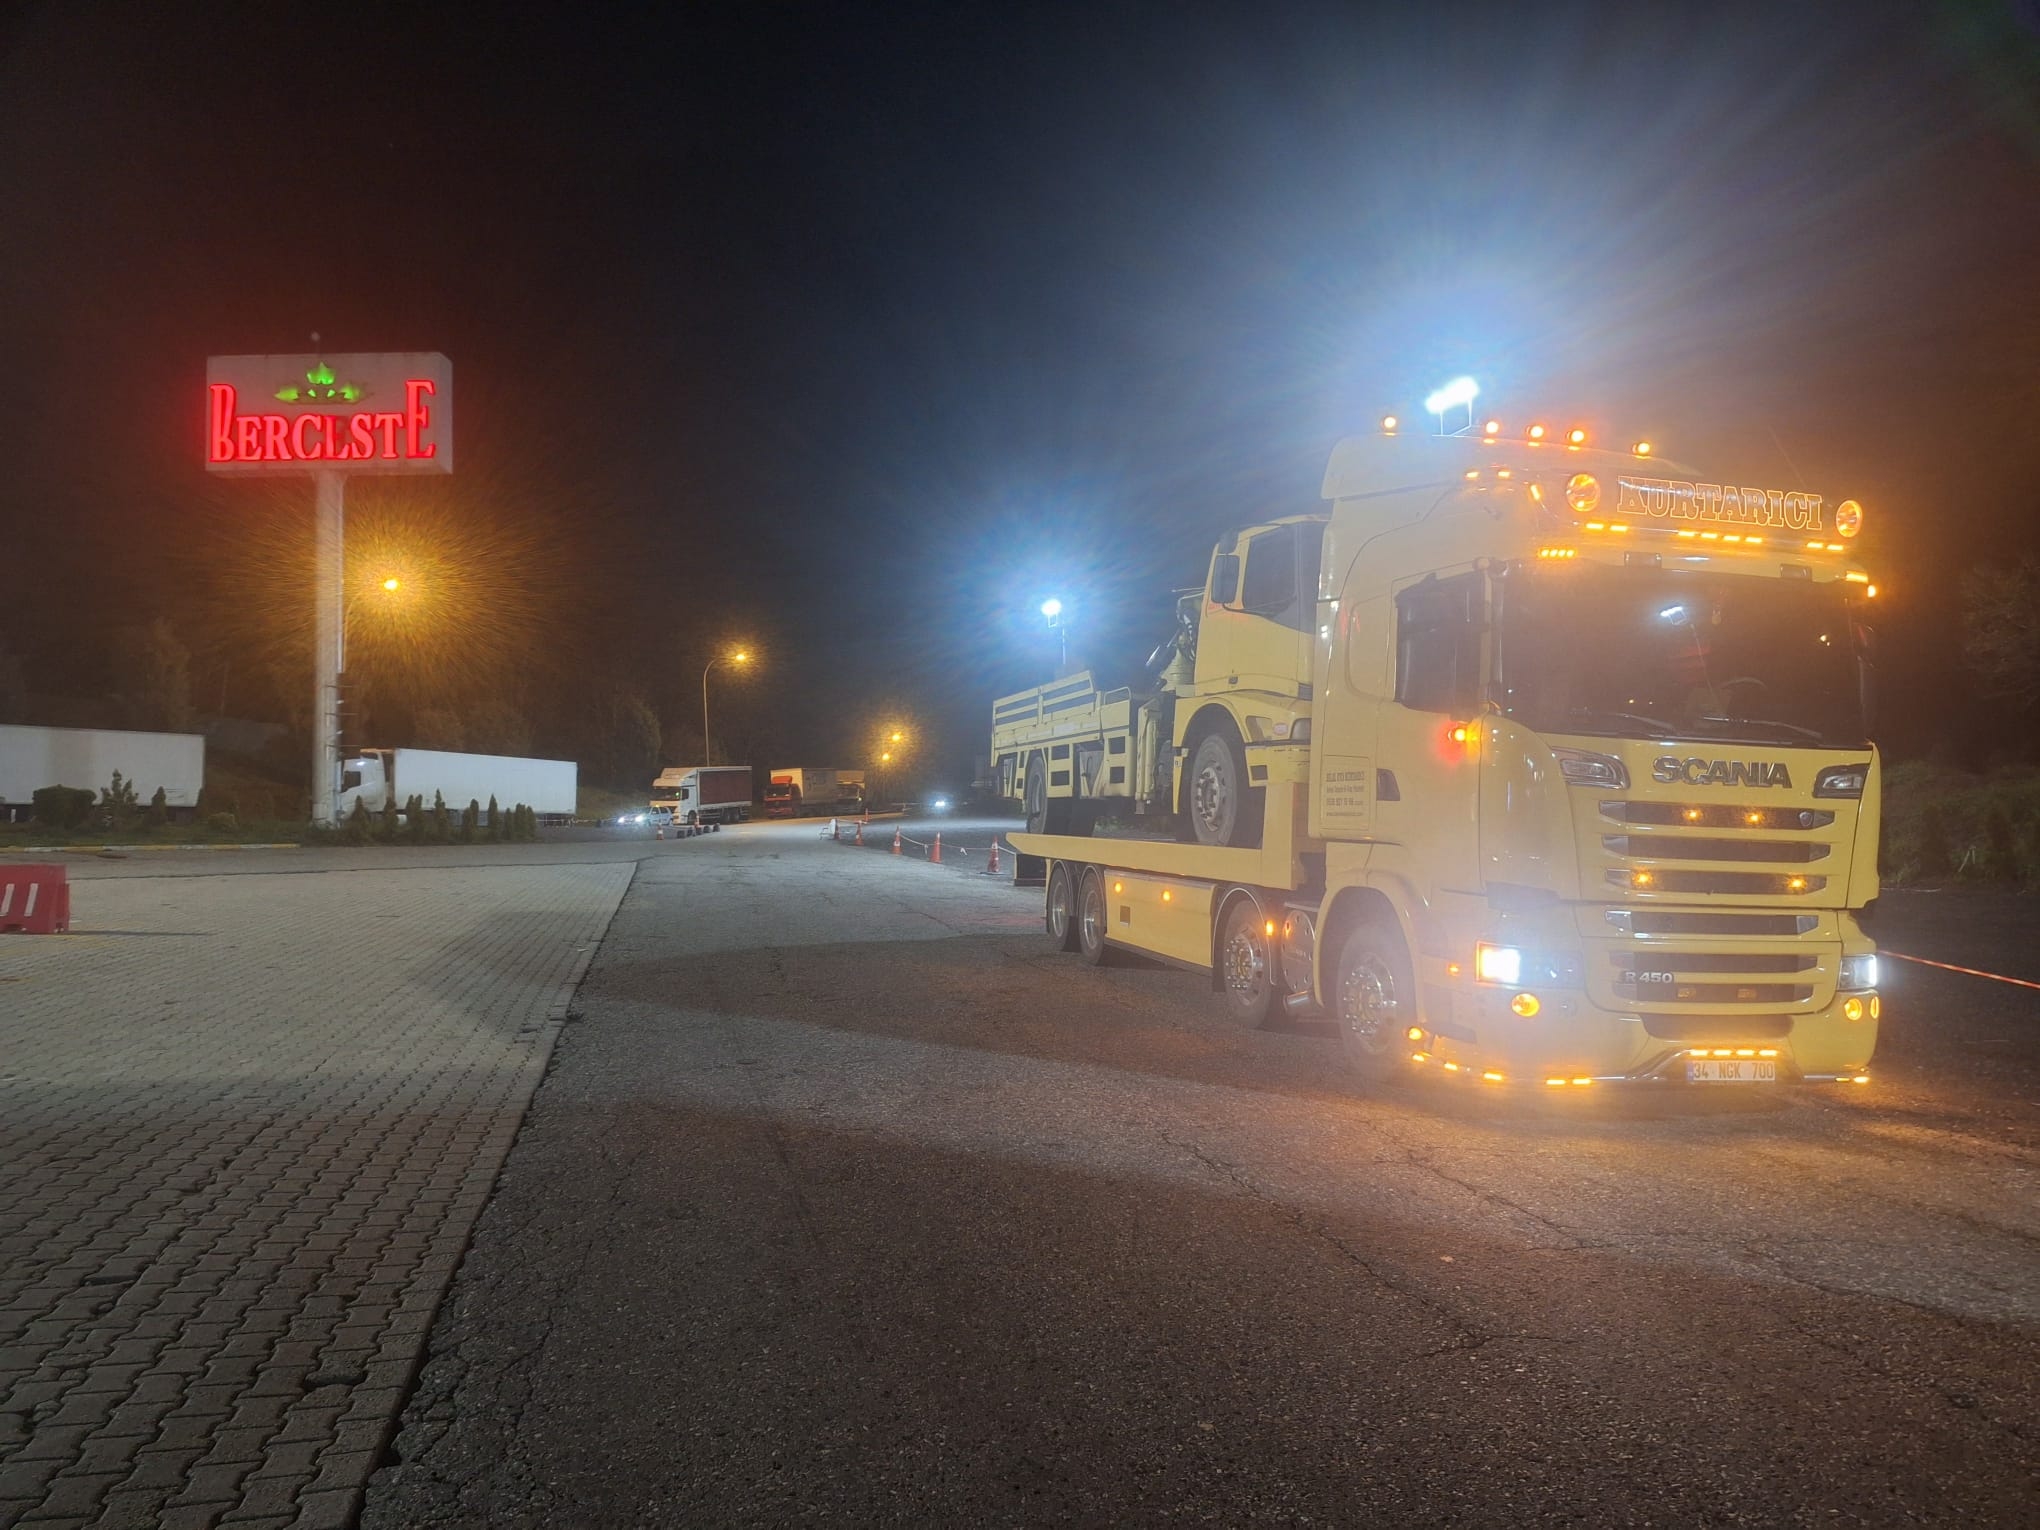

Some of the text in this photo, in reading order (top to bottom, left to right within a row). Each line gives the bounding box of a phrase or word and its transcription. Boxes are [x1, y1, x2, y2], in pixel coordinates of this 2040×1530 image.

[1617, 475, 1823, 531] KURTARICI
[1652, 756, 1792, 788] SCANIA
[1639, 971, 1673, 983] 450
[1694, 1062, 1774, 1079] 34 NGK 700
